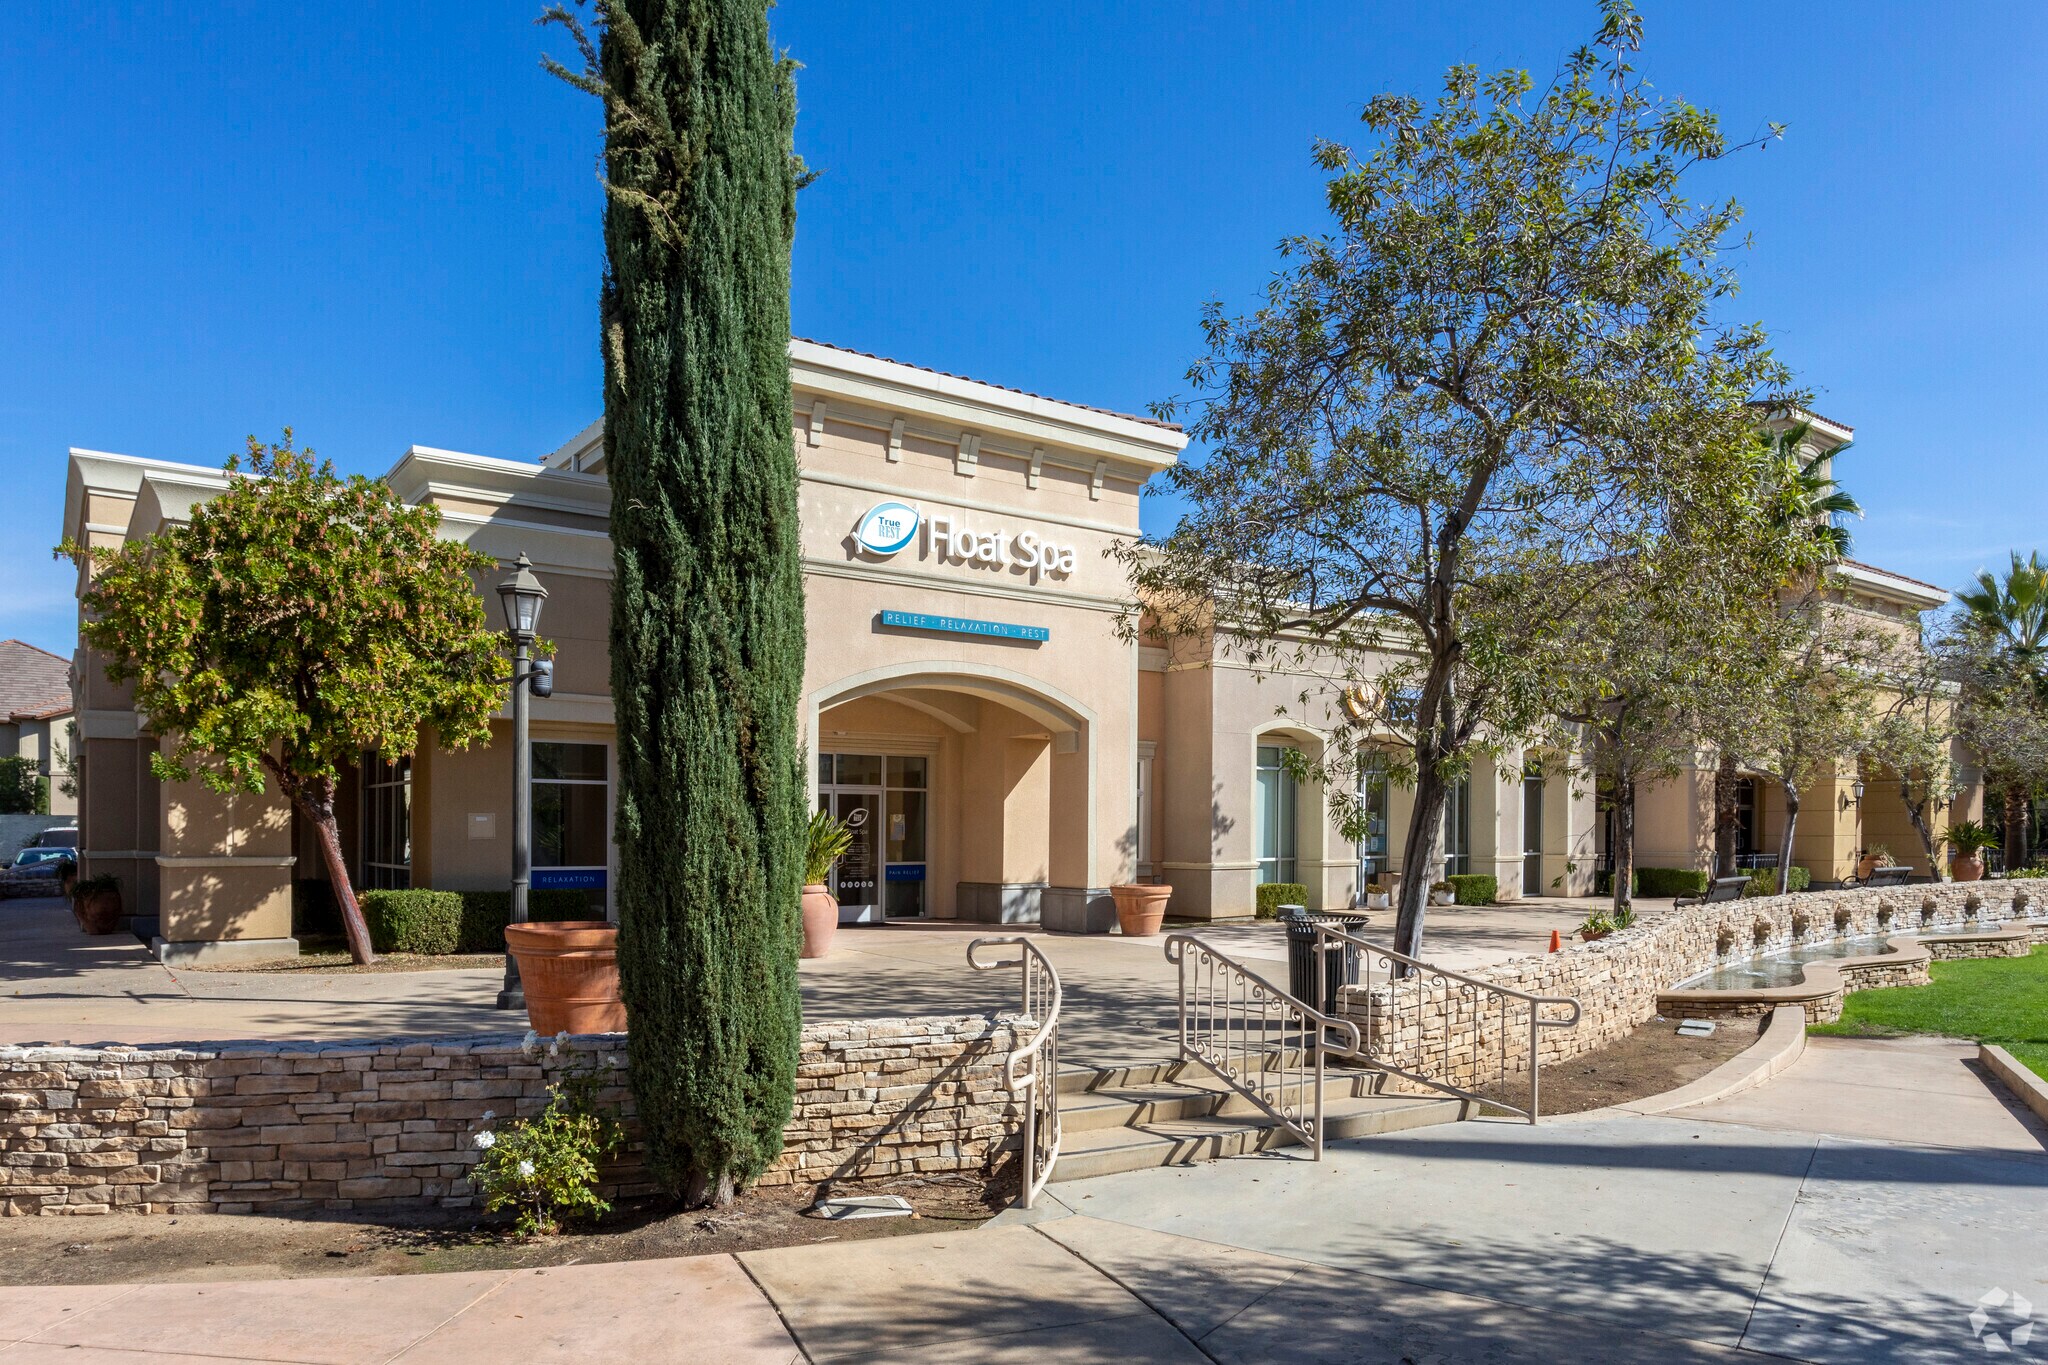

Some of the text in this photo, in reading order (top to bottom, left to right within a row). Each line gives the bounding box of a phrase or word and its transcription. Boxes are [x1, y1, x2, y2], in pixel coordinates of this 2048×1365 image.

[878, 516, 901, 528] True
[878, 525, 901, 540] REST
[928, 514, 1077, 579] Float Spa
[887, 613, 1045, 639] RELIEF RELAXATION REST
